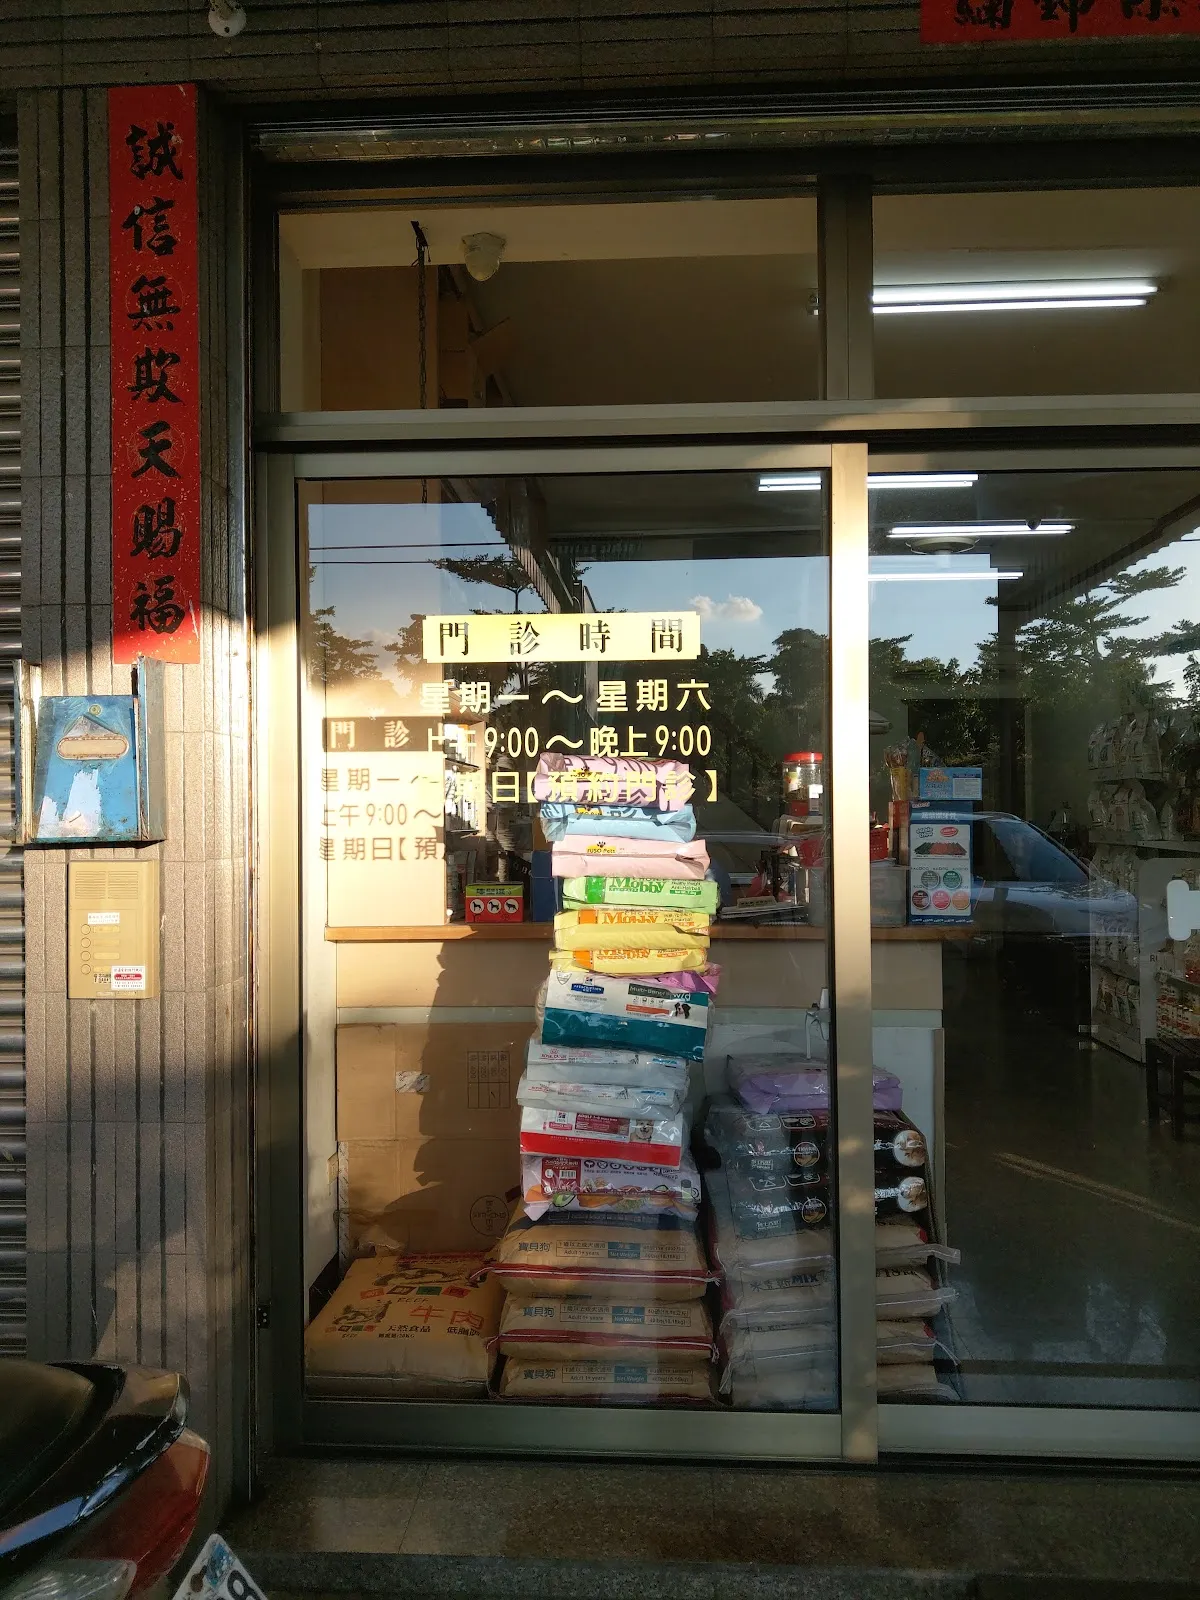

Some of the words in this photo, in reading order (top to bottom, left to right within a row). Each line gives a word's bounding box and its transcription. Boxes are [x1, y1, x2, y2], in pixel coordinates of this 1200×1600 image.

[122, 122, 186, 636] 誠信無欺天賜福
[439, 617, 684, 656] 門診時間
